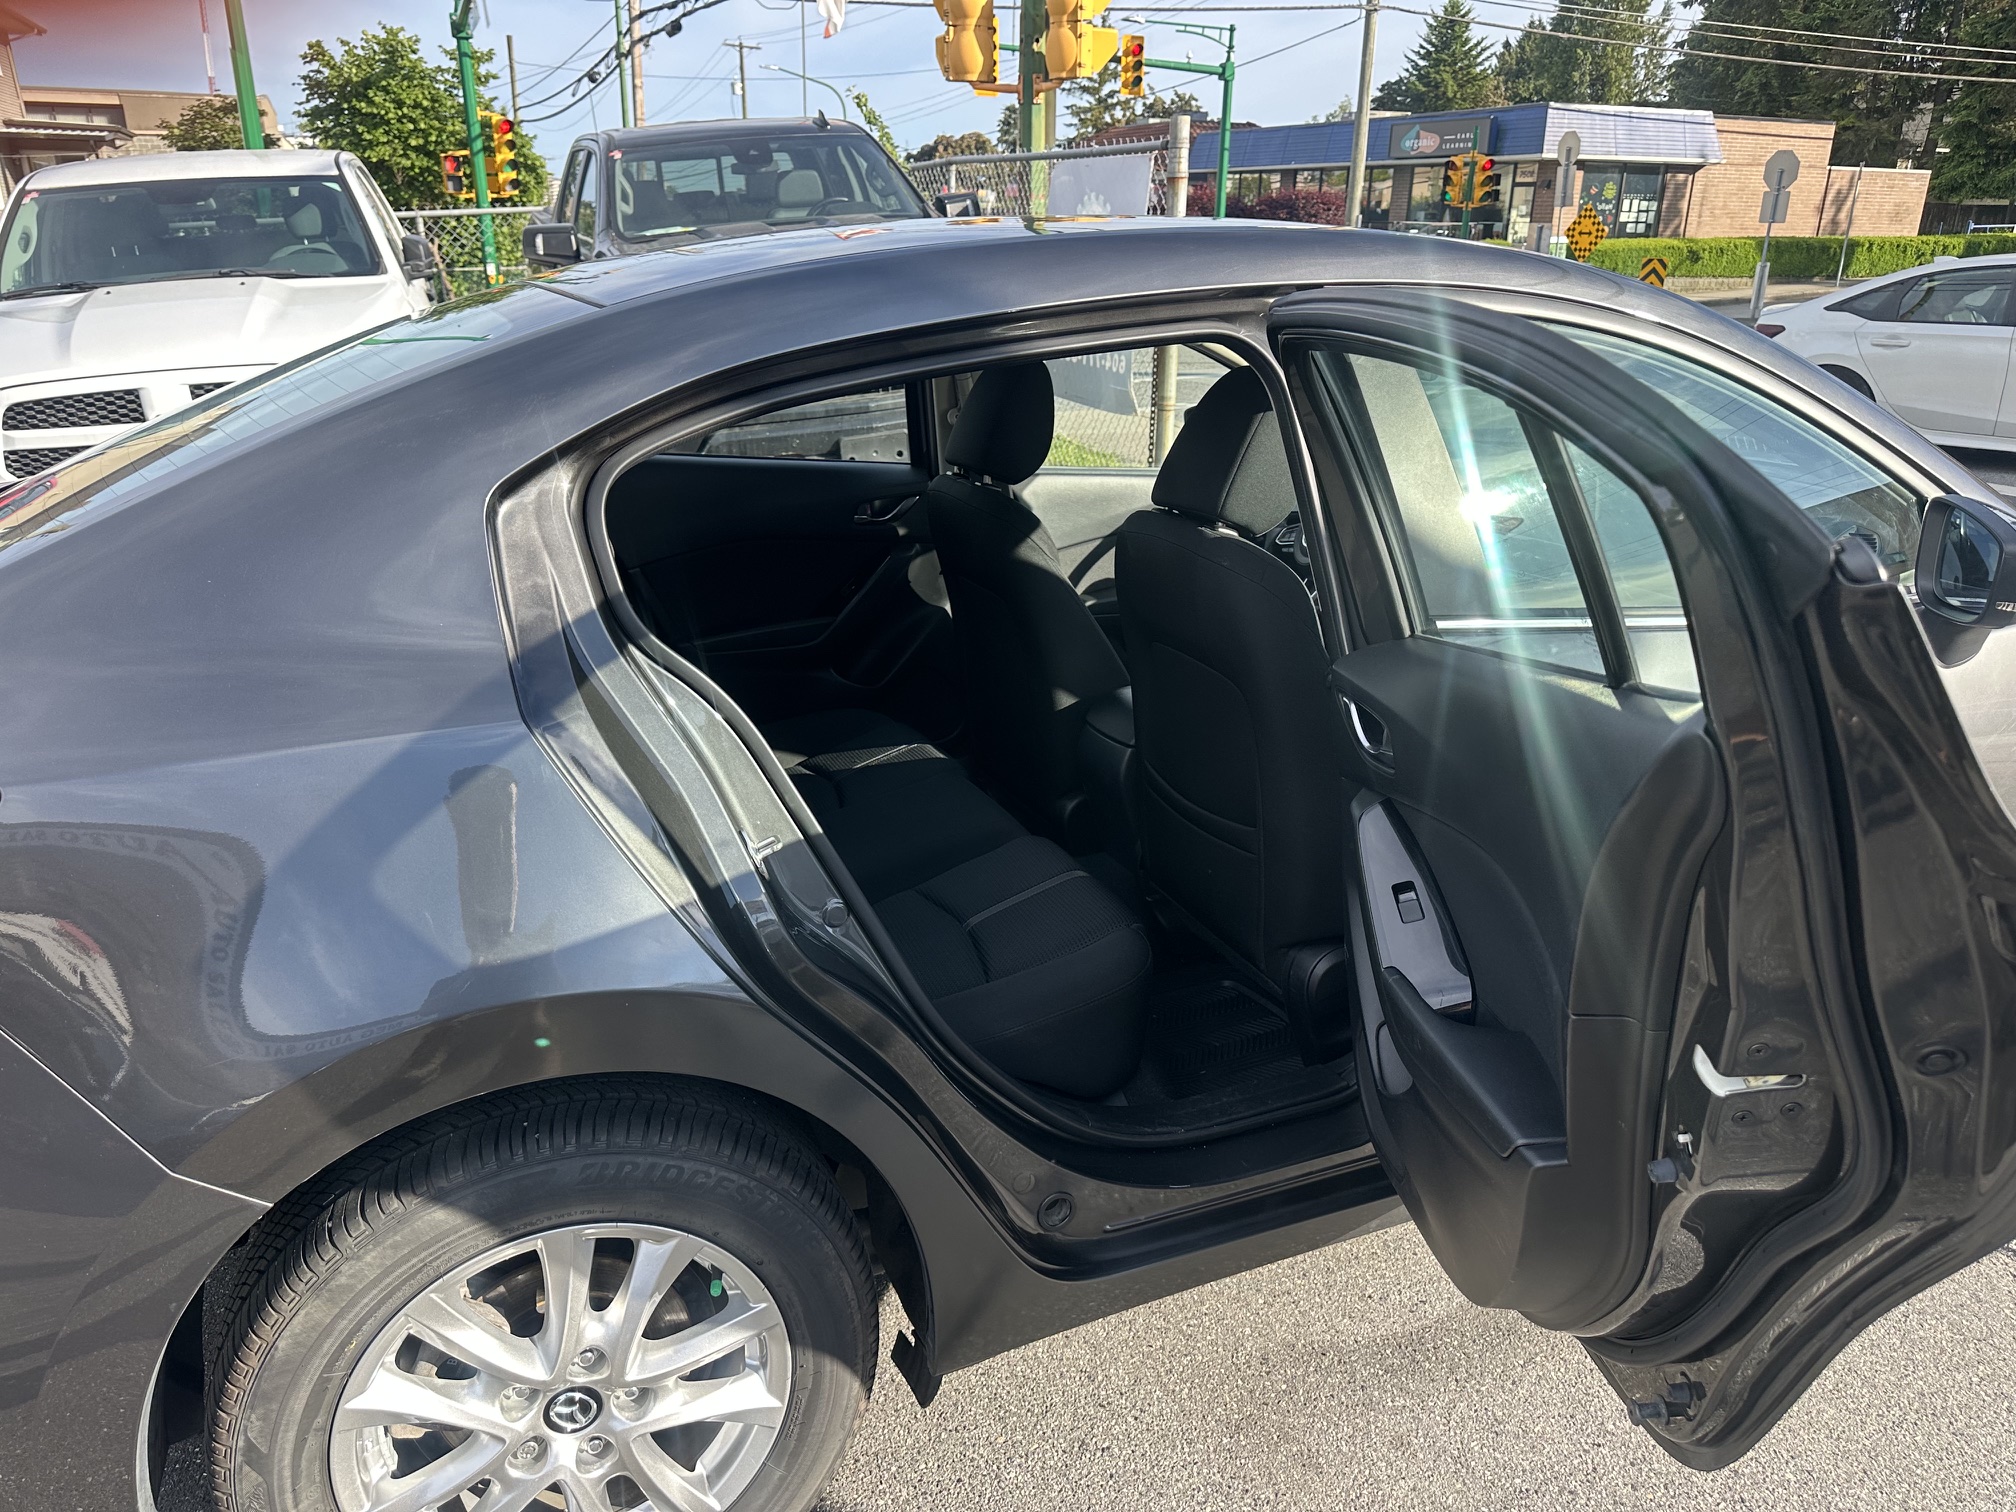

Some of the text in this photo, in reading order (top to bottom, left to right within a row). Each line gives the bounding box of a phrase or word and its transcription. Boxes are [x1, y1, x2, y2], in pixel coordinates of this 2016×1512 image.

[1405, 137, 1435, 149] organic
[1442, 141, 1472, 149] LEARNIN
[576, 1161, 800, 1222] BRIDGESTO
